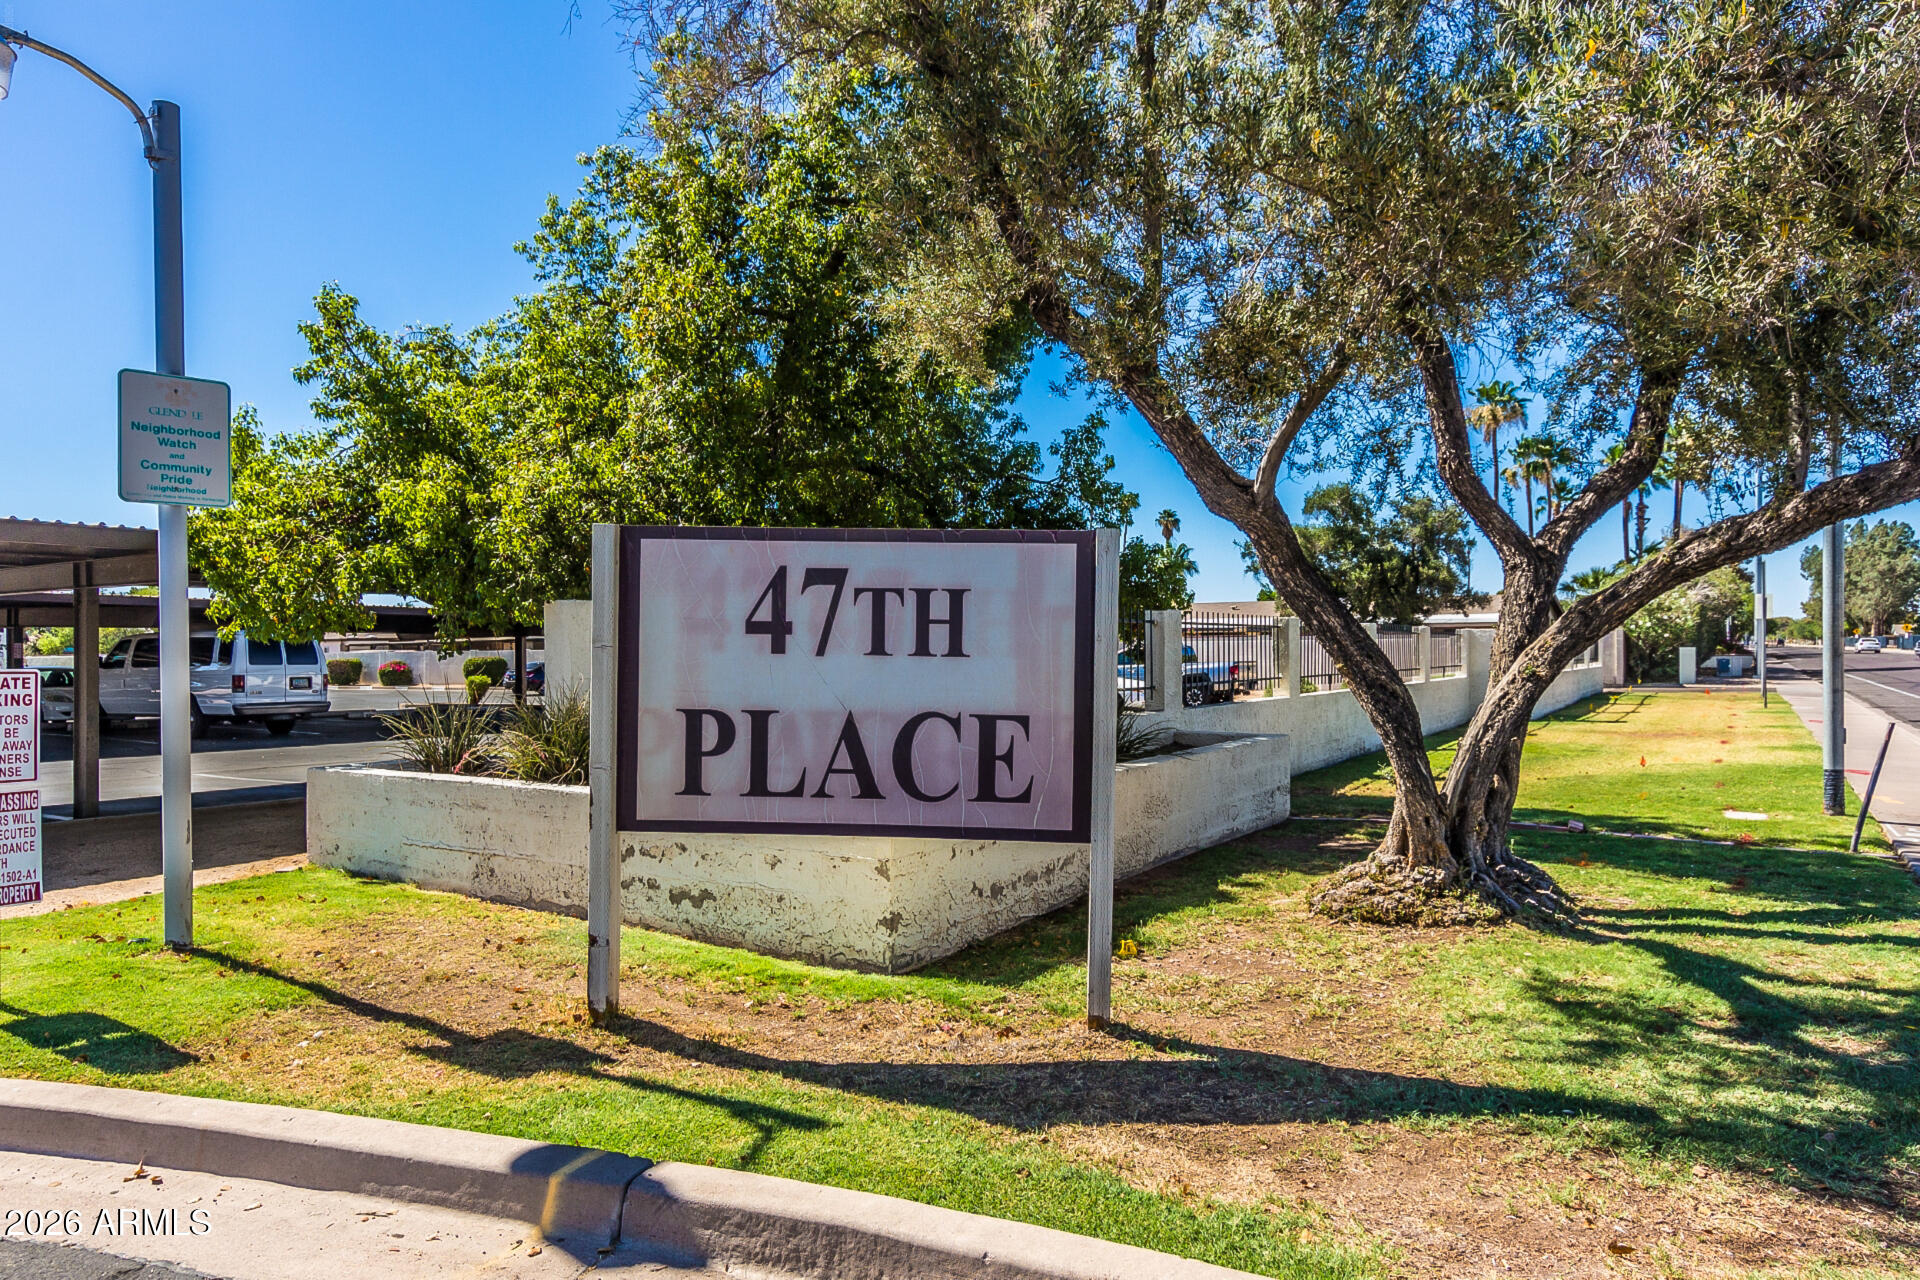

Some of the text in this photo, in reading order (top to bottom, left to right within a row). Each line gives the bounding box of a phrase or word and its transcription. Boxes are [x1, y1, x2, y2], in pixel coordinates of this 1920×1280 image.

[148, 406, 204, 420] GLENDLE
[130, 421, 221, 440] Neighborhood
[157, 437, 197, 450] Watch
[140, 460, 212, 476] Community
[161, 474, 193, 485] Pride
[744, 564, 971, 658] 47TH
[0, 677, 31, 690] ATE
[4, 728, 19, 738] BE
[2, 739, 33, 752] AWAY
[0, 753, 30, 765] NERS
[674, 708, 1034, 804] PLACE
[0, 766, 22, 778] NSE
[0, 792, 38, 811] ASSING
[12, 812, 36, 825] WILL
[0, 840, 36, 855] DANCE
[0, 857, 8, 870] H
